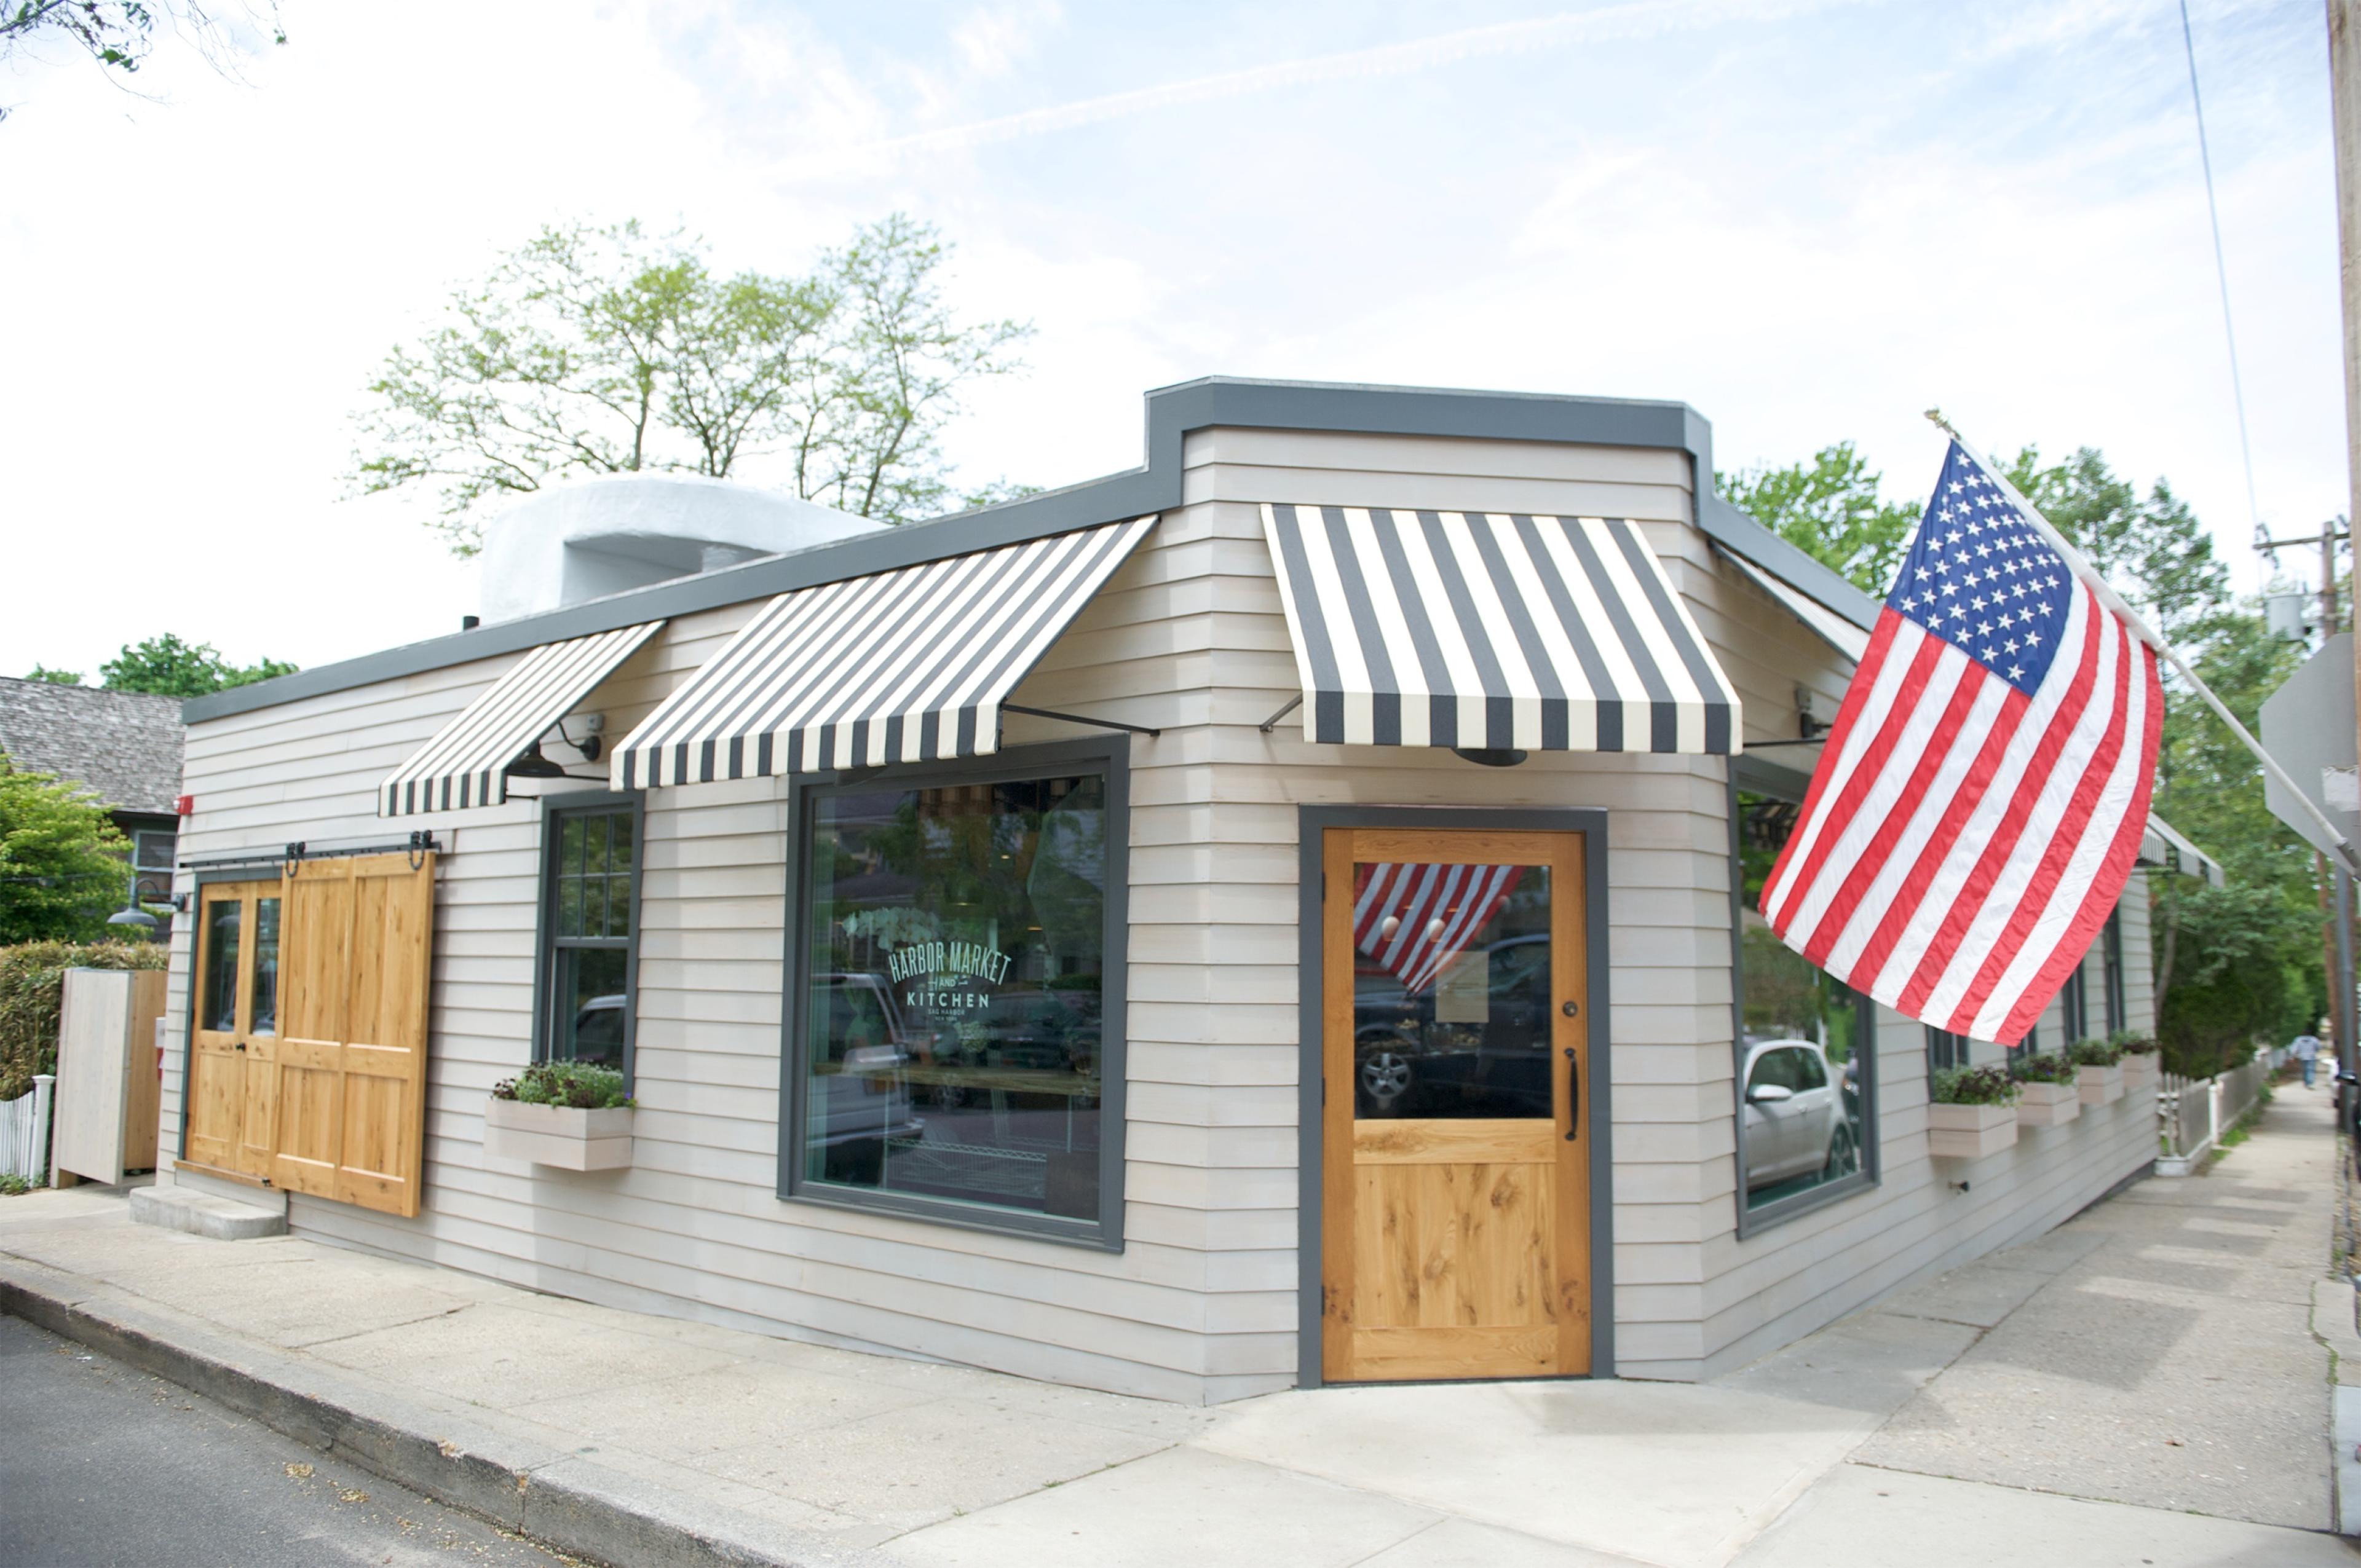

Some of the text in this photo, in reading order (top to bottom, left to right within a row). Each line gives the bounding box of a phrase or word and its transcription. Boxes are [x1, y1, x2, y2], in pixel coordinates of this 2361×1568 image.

[888, 942, 1011, 985] HARBOR MARKET
[939, 979, 956, 987] AND
[907, 991, 989, 1008] KITCHEN
